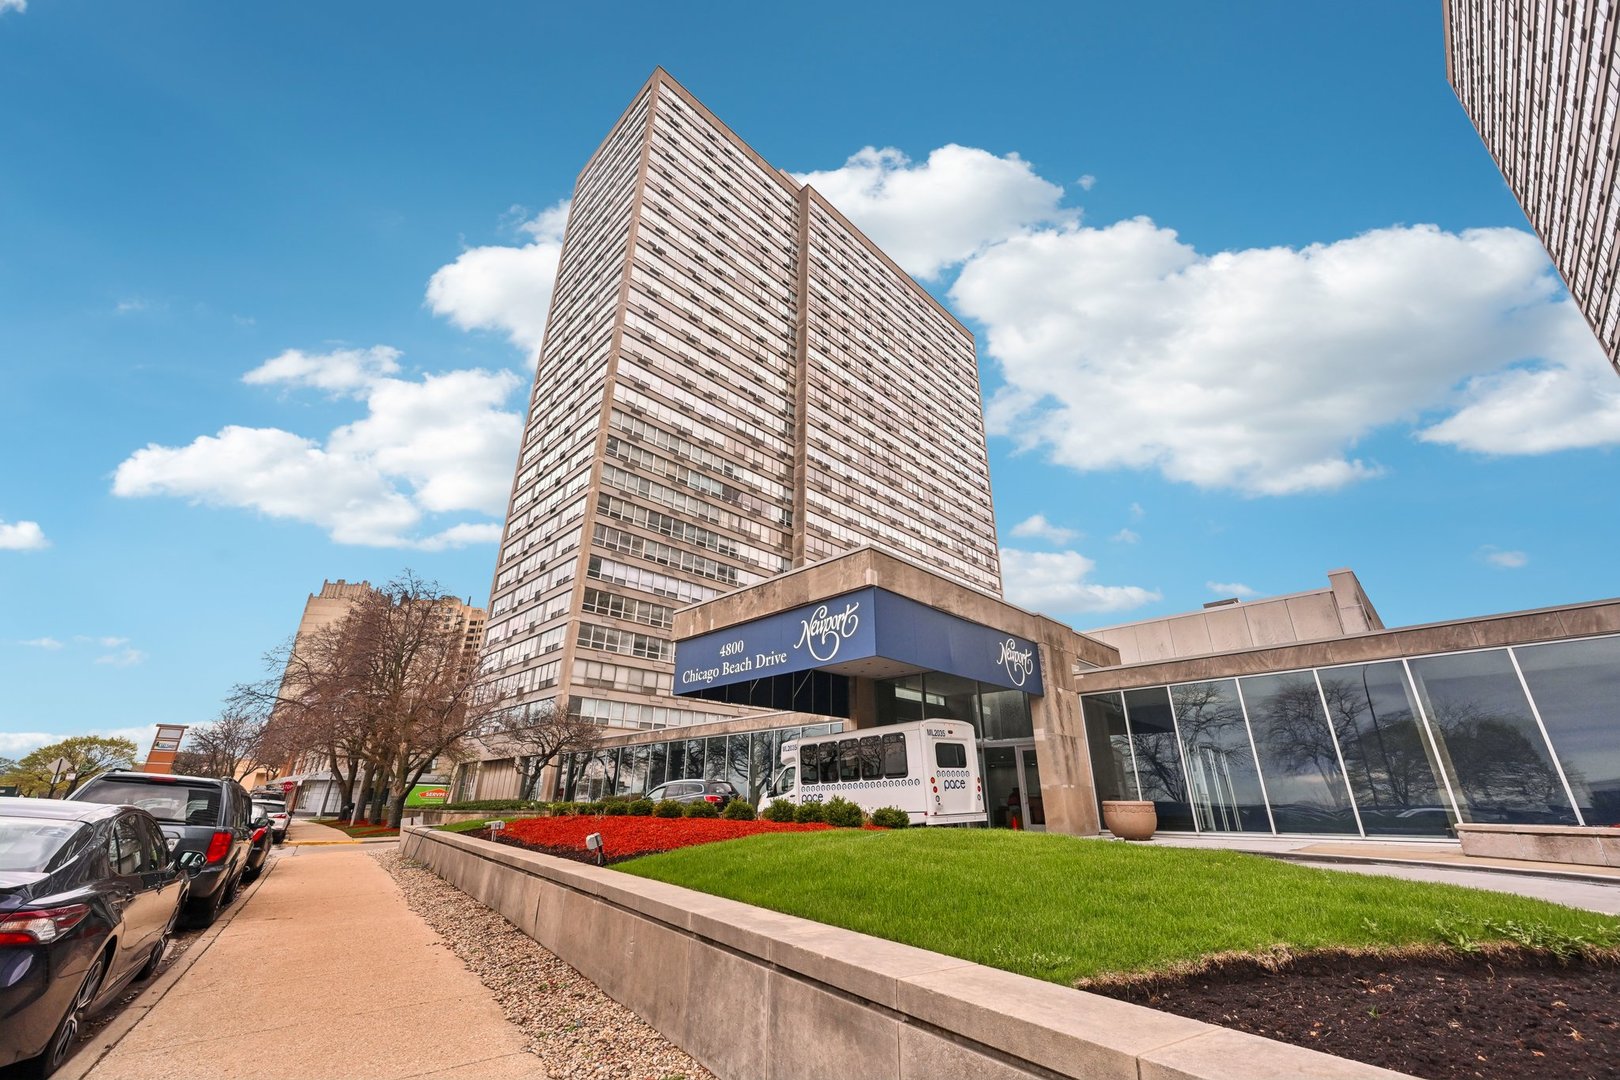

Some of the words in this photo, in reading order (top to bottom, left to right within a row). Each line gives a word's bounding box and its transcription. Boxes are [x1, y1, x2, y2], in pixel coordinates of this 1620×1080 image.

[793, 602, 859, 661] Newport
[720, 640, 744, 657] 4800
[682, 668, 719, 683] Chicago
[722, 657, 752, 676] Beach
[755, 651, 787, 669] Drive
[996, 638, 1033, 686] Newport
[943, 779, 966, 791] pace
[801, 793, 824, 804] pace
